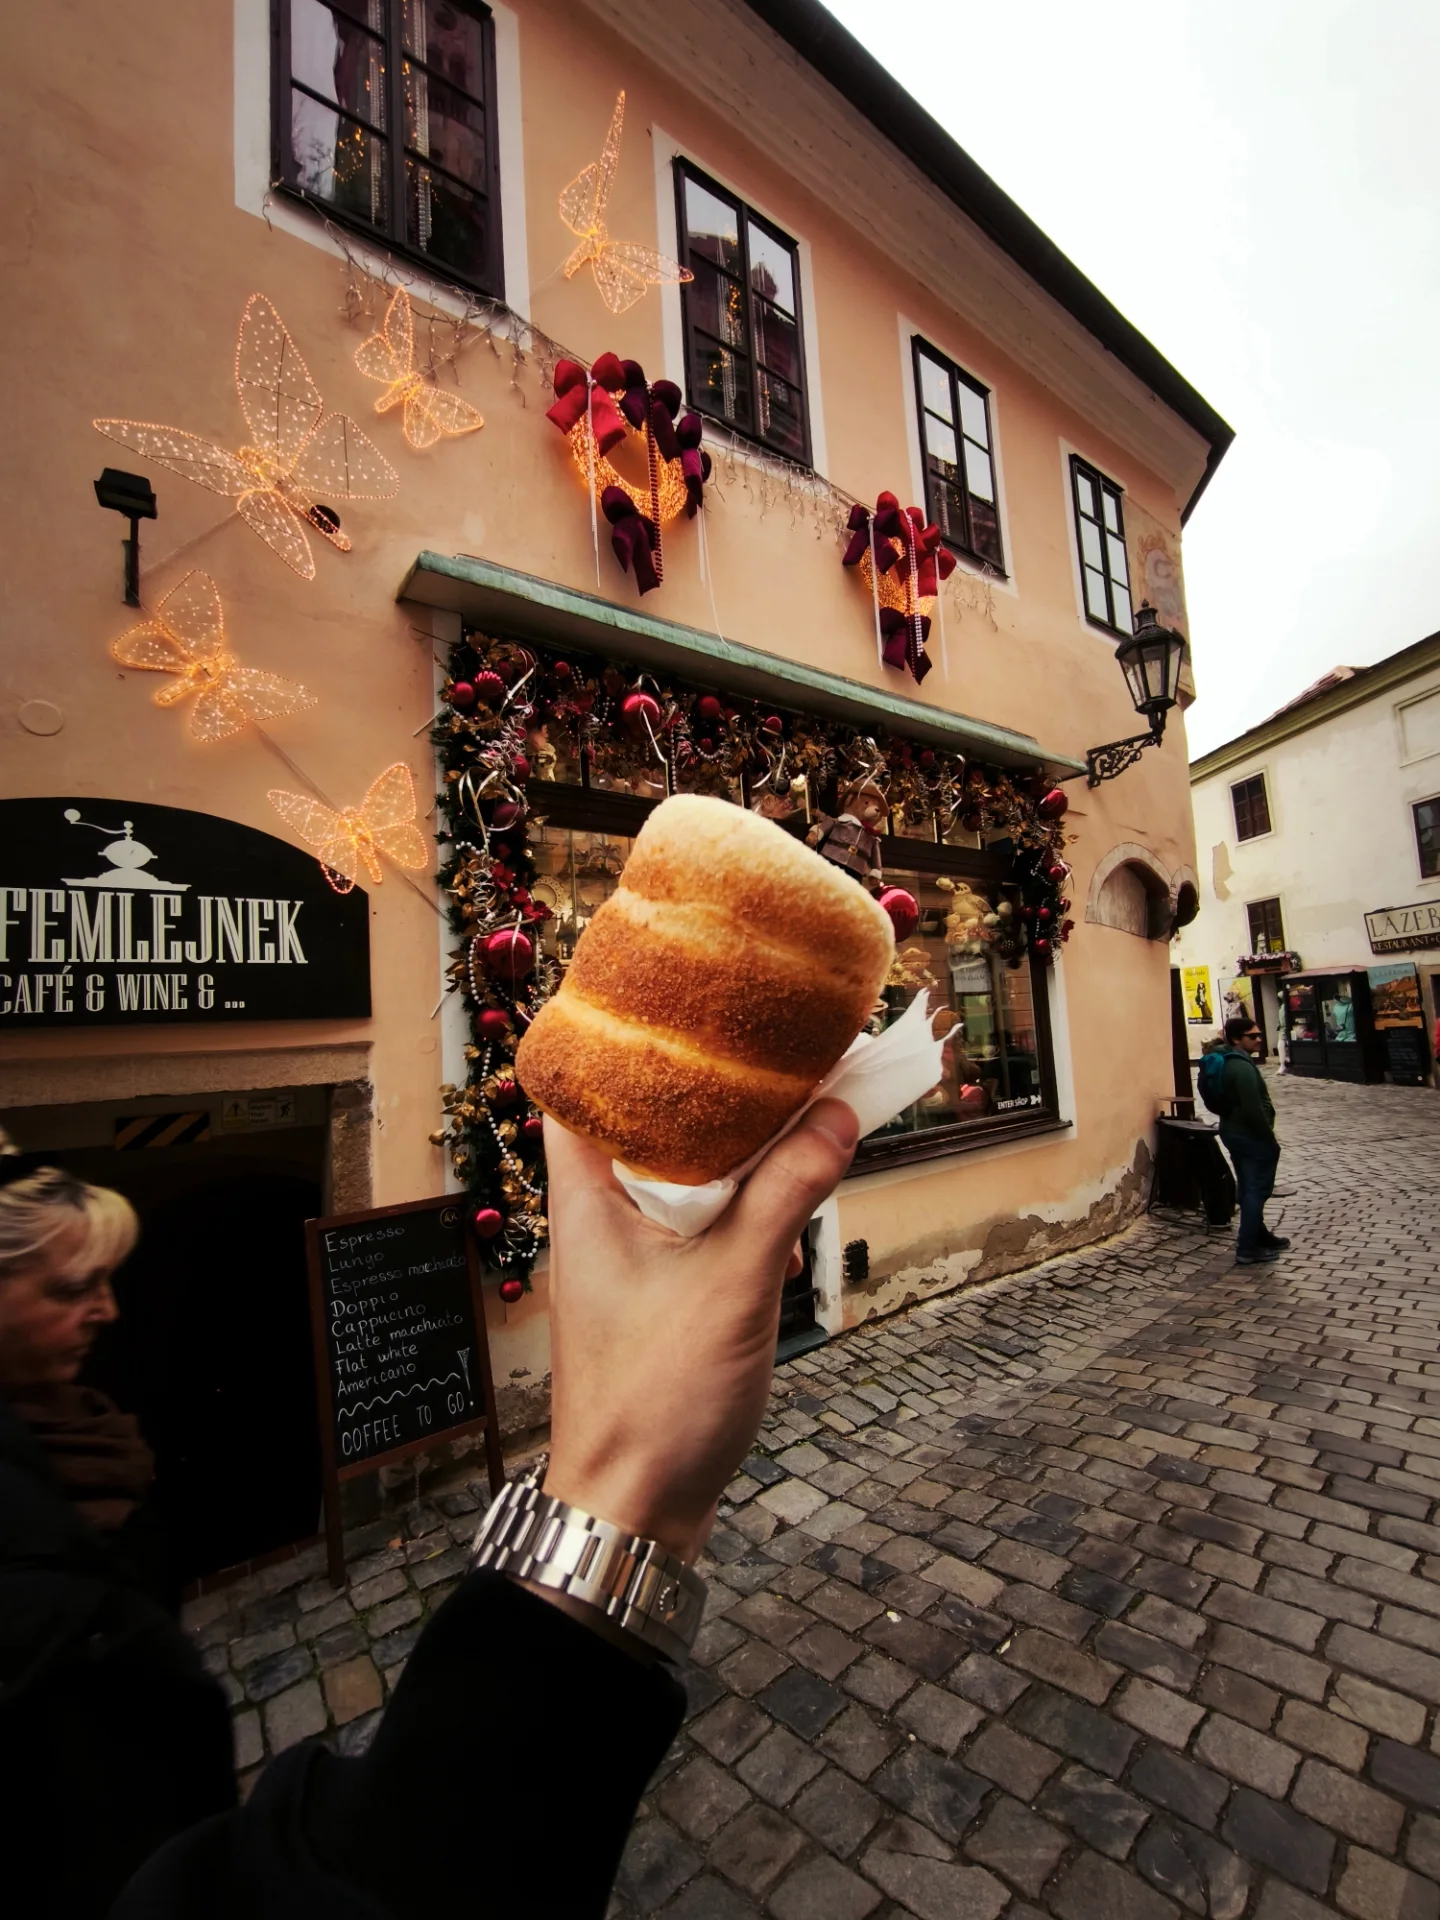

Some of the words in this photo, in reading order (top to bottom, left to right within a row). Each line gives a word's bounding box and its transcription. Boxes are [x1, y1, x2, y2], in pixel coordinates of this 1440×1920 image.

[1373, 935, 1430, 951] RESTAURANT
[0, 966, 74, 1015] CAFÉ
[86, 973, 105, 1012] &
[117, 973, 188, 1011] WINE
[198, 973, 215, 1010] &
[997, 1099, 1014, 1110] ENTER
[1014, 1096, 1029, 1106] SHOP
[325, 1226, 405, 1253] Espresso
[329, 1251, 385, 1273] Lungo
[331, 1269, 402, 1296] Espresso
[331, 1291, 399, 1318] Doppio
[332, 1303, 427, 1338] Cappucino
[336, 1334, 381, 1355] Latte
[390, 1313, 463, 1341] macchiato
[336, 1356, 368, 1375] Flat
[379, 1342, 419, 1363] white
[338, 1362, 416, 1397] Americano
[342, 1414, 400, 1456] COFFEE
[417, 1404, 432, 1427] TO
